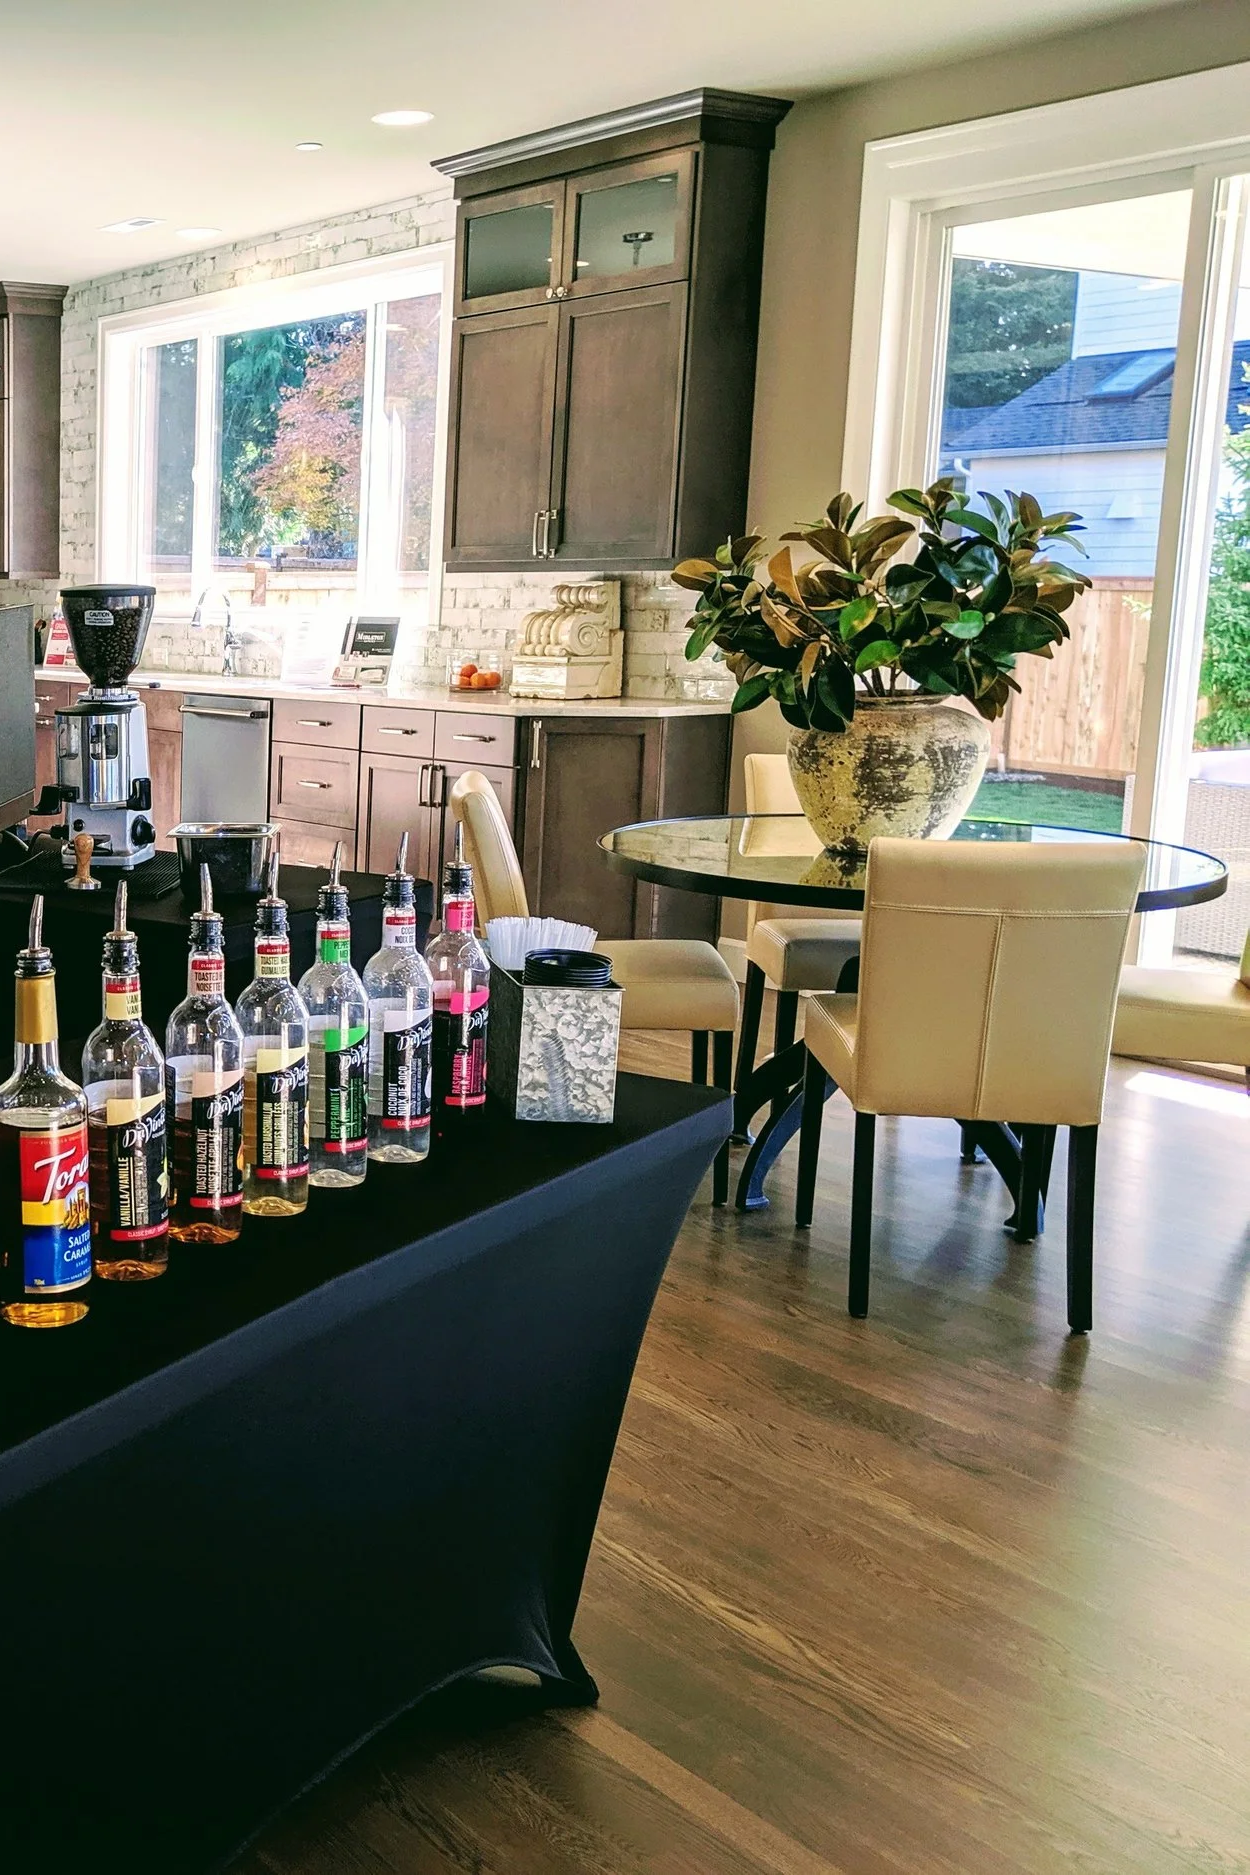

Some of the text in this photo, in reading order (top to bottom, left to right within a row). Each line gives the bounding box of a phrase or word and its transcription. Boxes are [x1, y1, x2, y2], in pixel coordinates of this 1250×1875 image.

[195, 971, 219, 981] TOASTED
[397, 1065, 408, 1083] COCO
[330, 1091, 341, 1139] PEPPERMINT
[387, 1082, 398, 1116] COCONUT
[196, 1128, 208, 1194] TOASTED HAZELNUT
[118, 1156, 131, 1227] VANILLA/VANILLE
